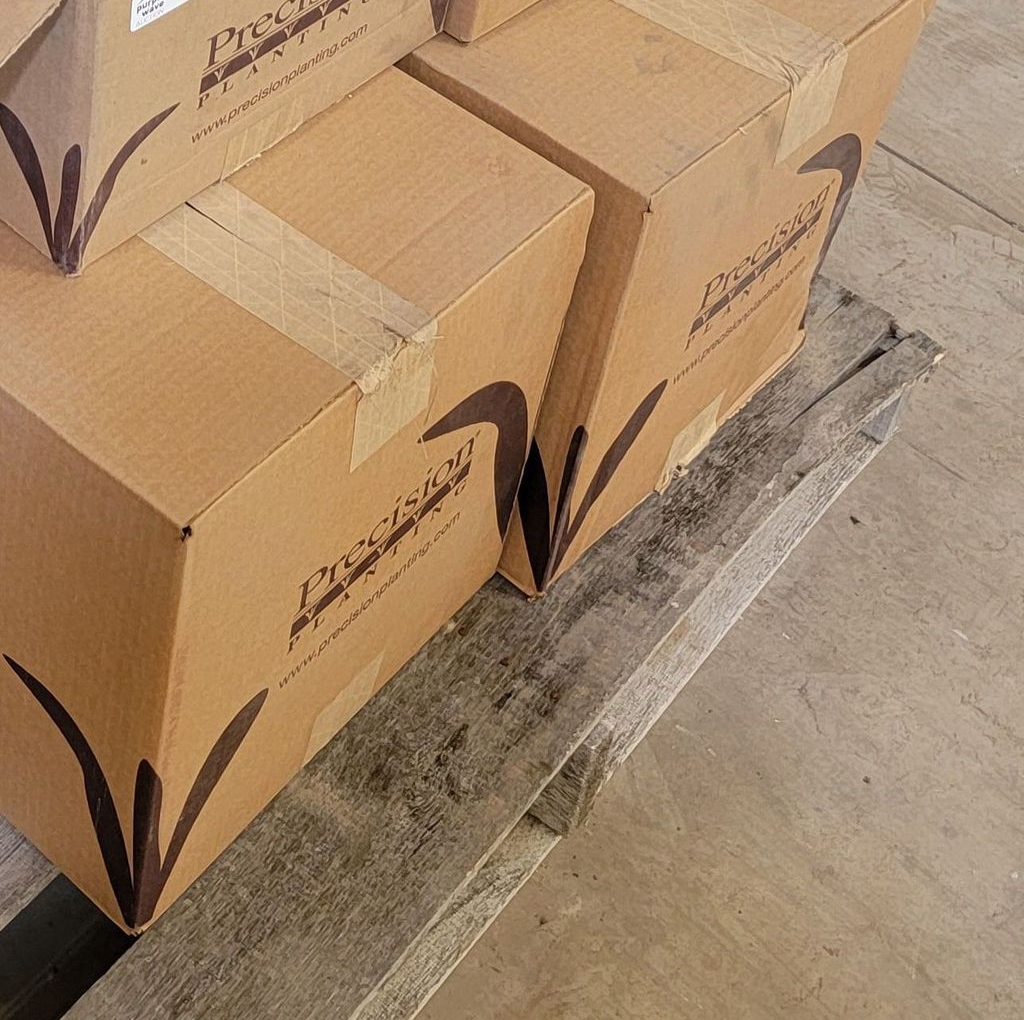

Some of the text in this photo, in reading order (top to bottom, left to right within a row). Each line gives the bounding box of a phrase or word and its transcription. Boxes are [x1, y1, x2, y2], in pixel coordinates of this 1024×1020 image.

[142, 0, 165, 18] wave
[191, 23, 368, 144] www.precisionplanting.com
[278, 511, 461, 689] www.precisionplanting.com
[287, 479, 467, 655] PLANTING
